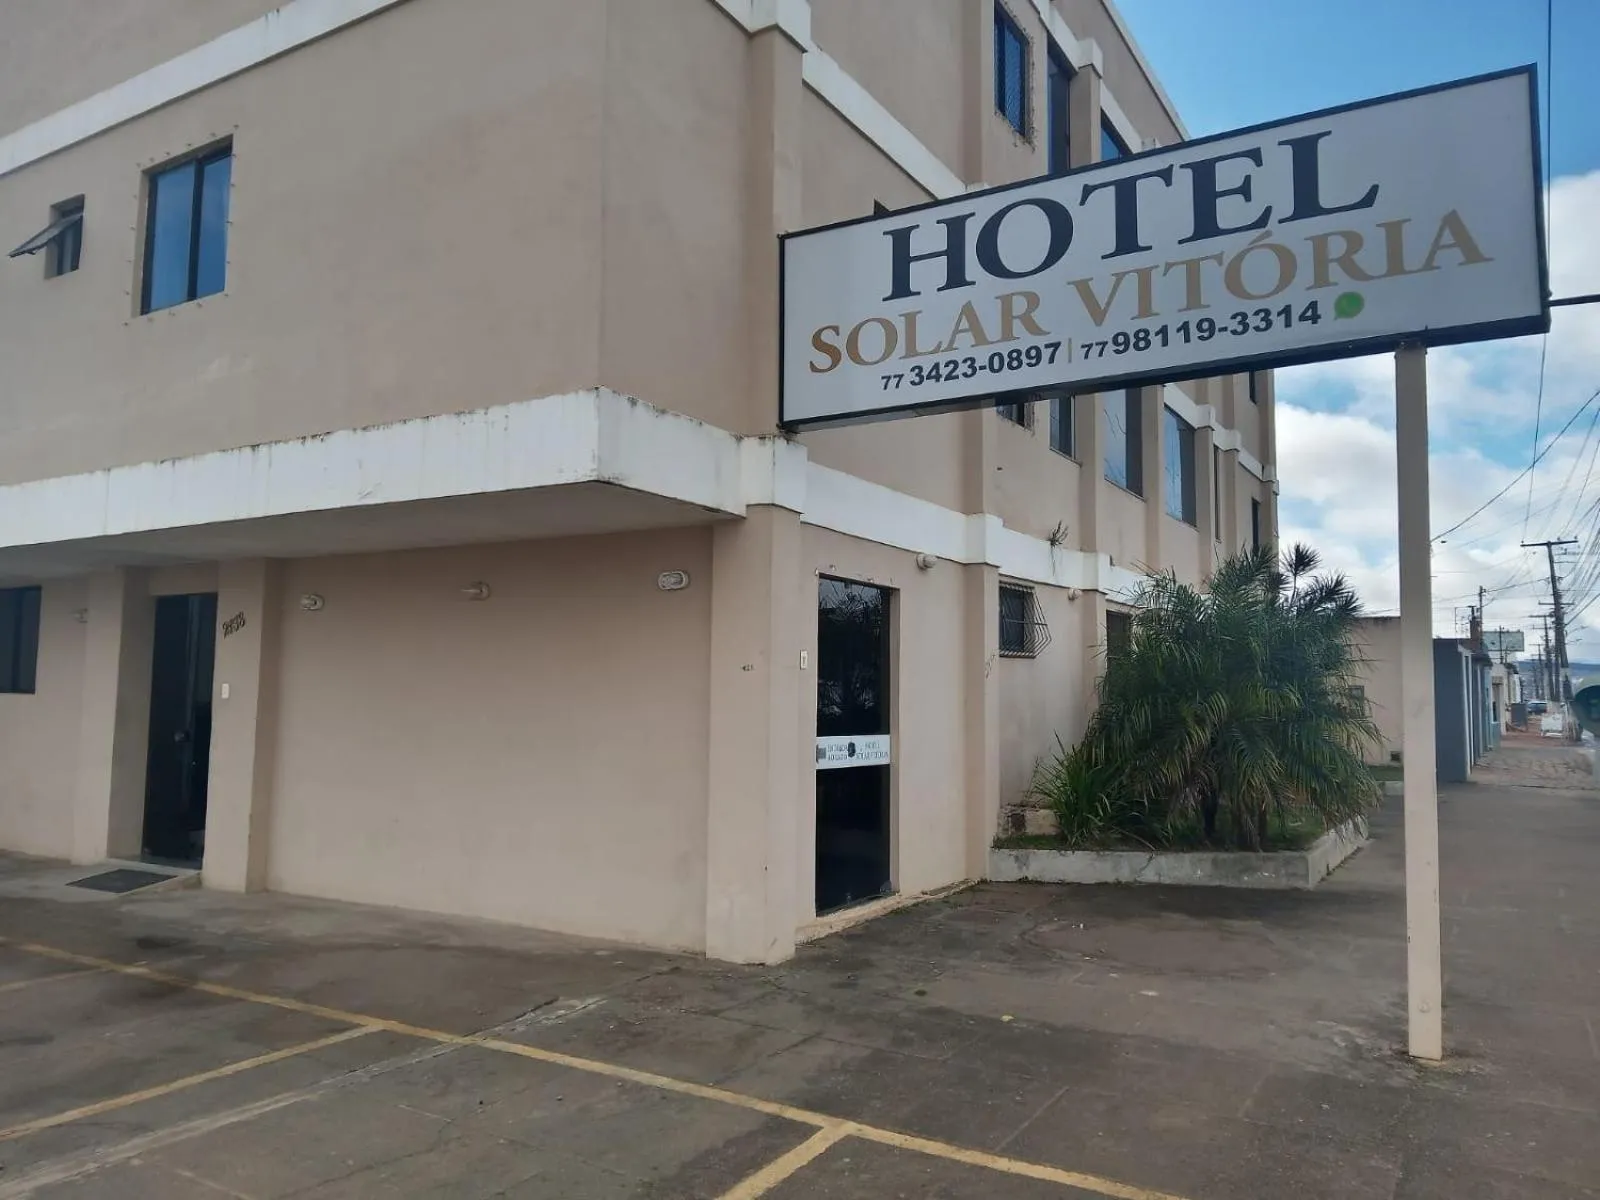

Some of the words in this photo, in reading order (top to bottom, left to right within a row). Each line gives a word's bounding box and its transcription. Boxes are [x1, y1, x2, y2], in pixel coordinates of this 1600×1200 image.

[808, 290, 1052, 373] SOLAR
[1066, 208, 1495, 327] VITÓRIA
[882, 130, 1380, 302] HOTEL
[880, 373, 905, 391] 77
[908, 341, 1062, 386] 3423-0897
[1079, 340, 1109, 361] 77
[1111, 300, 1322, 355] 98119-3314
